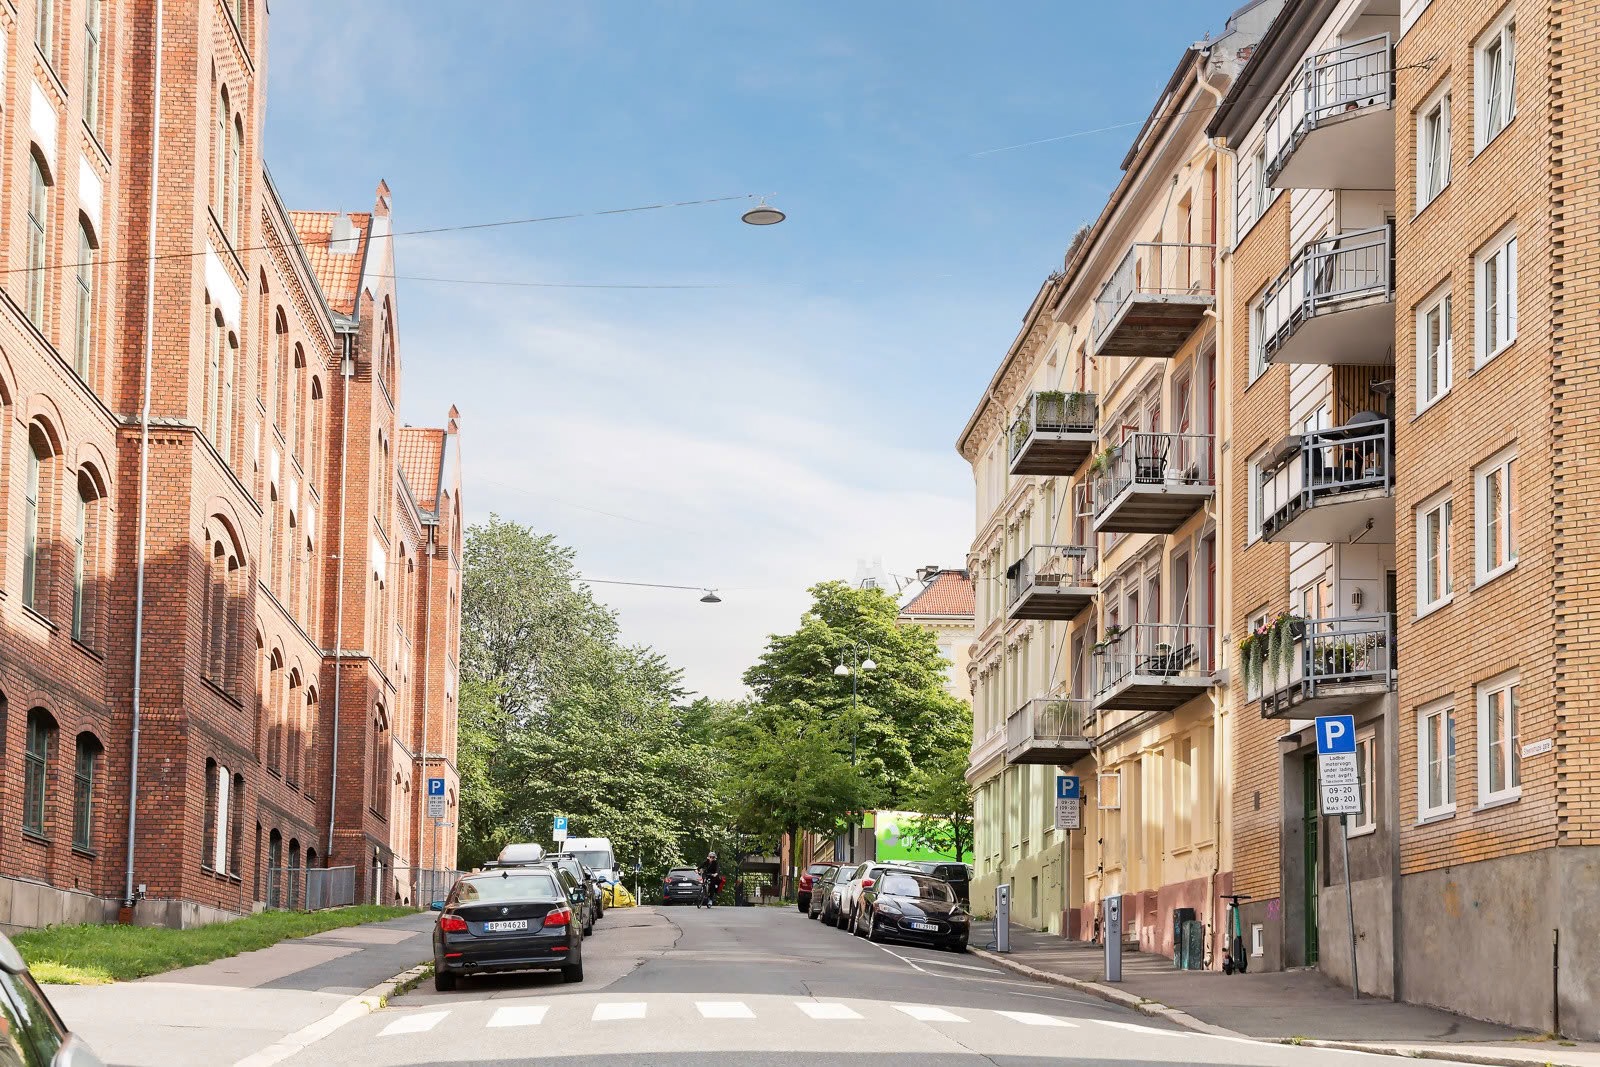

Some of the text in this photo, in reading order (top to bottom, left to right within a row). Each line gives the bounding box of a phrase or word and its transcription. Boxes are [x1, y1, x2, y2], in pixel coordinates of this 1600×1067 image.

[1325, 721, 1345, 749] P
[432, 780, 441, 794] P
[1062, 778, 1074, 796] P
[556, 820, 564, 828] P
[502, 921, 526, 929] 94628
